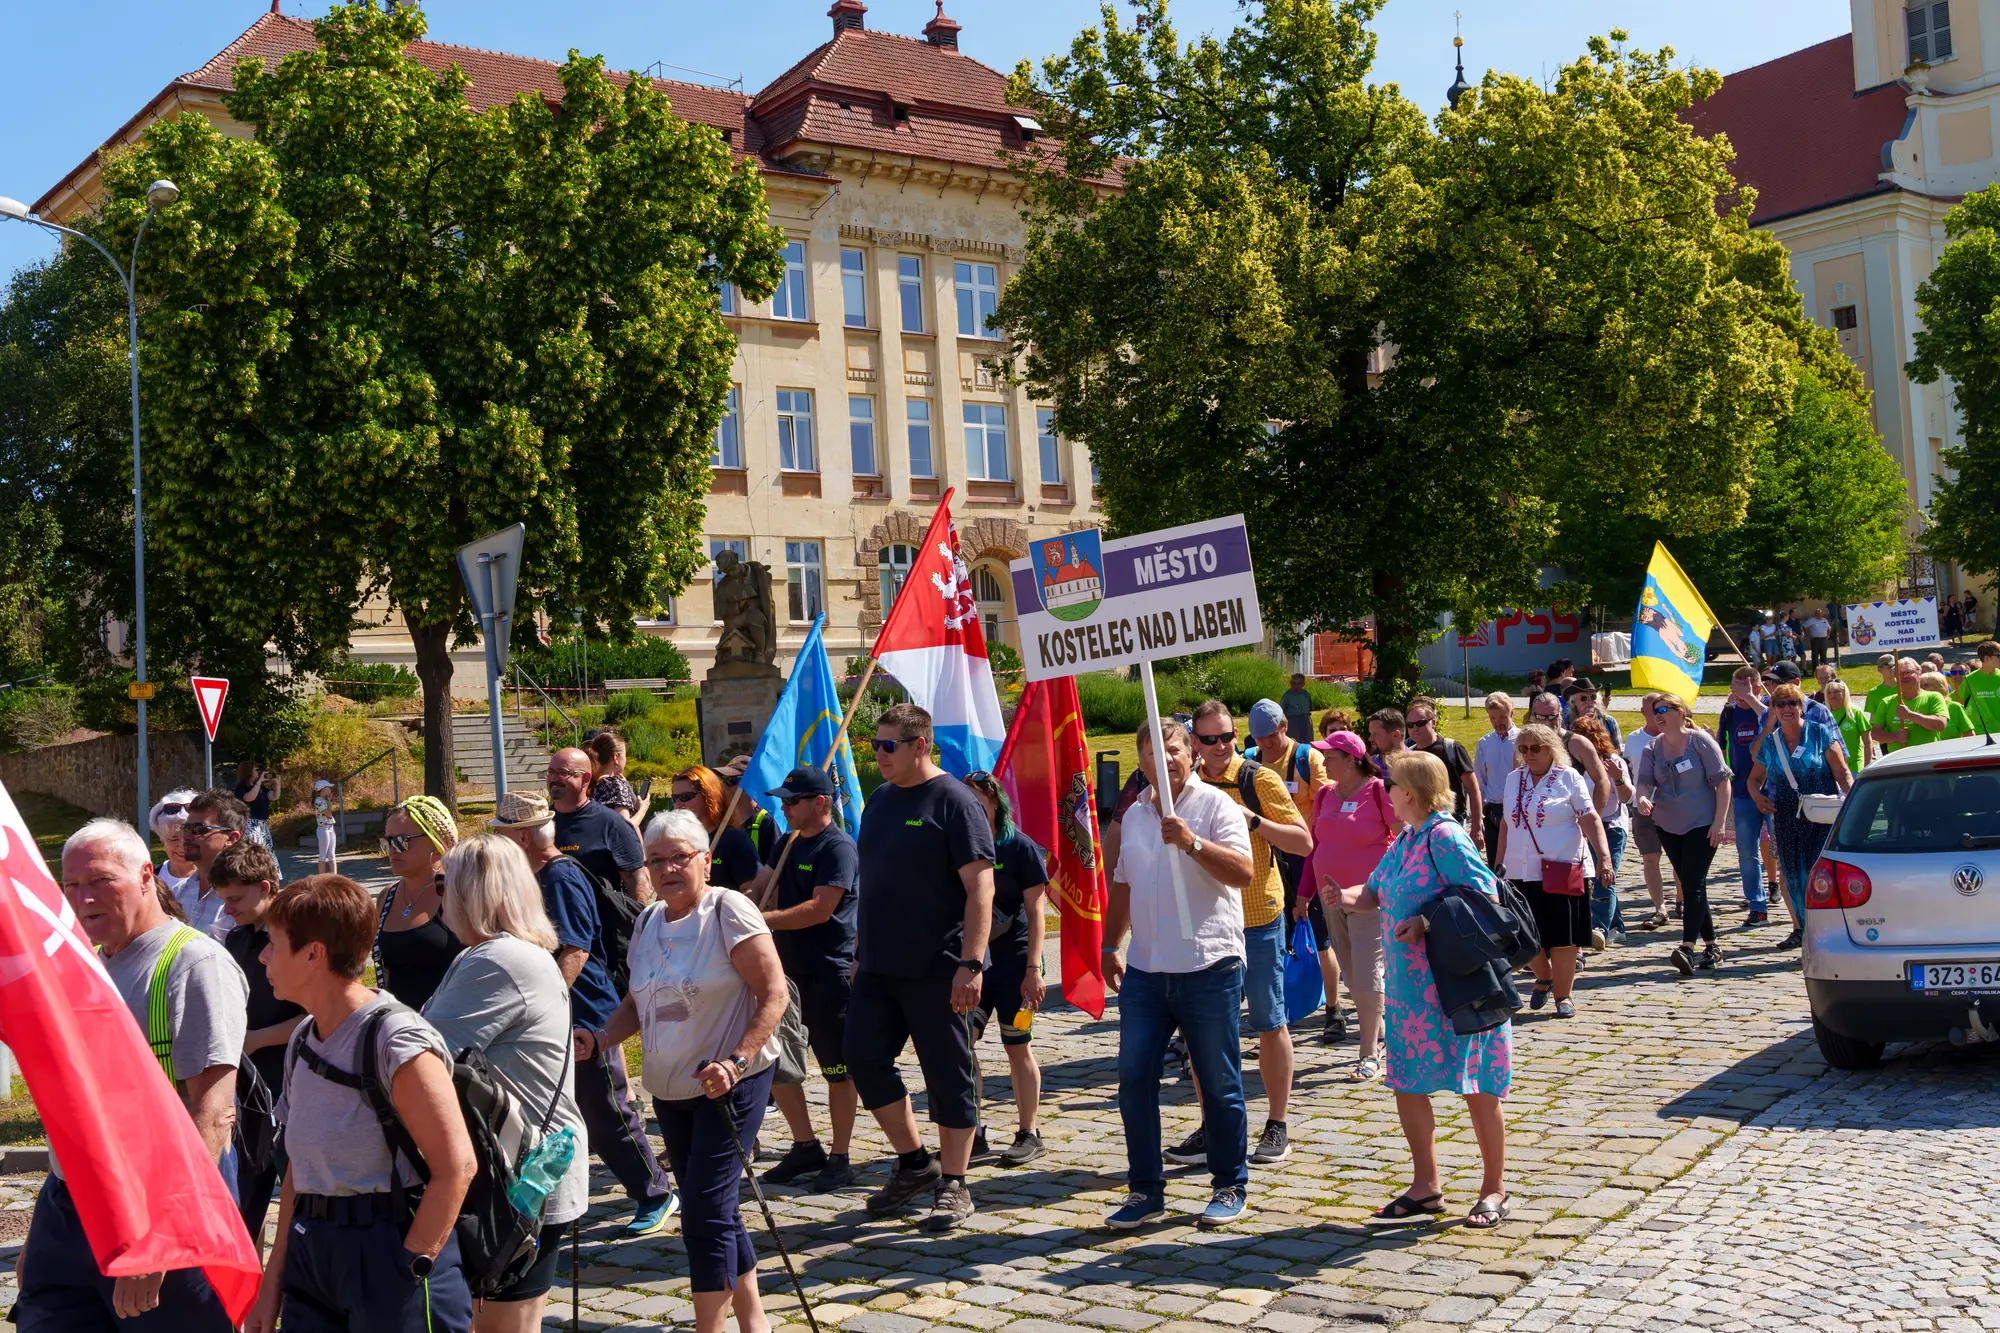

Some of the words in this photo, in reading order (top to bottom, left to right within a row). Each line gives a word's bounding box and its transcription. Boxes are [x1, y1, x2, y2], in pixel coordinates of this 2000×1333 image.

[1134, 544, 1217, 586] MĚSTO
[1891, 609, 1918, 618] MĚSTO
[1885, 617, 1926, 628] KOSTELEC
[1038, 618, 1134, 668] KOSTELEC
[1136, 610, 1177, 651] NAD
[1180, 597, 1247, 643] LABEM
[1878, 637, 1914, 646] ČERNÝMI
[1929, 966, 1965, 986] 3Z3
[820, 1064, 847, 1075] ASIČI
